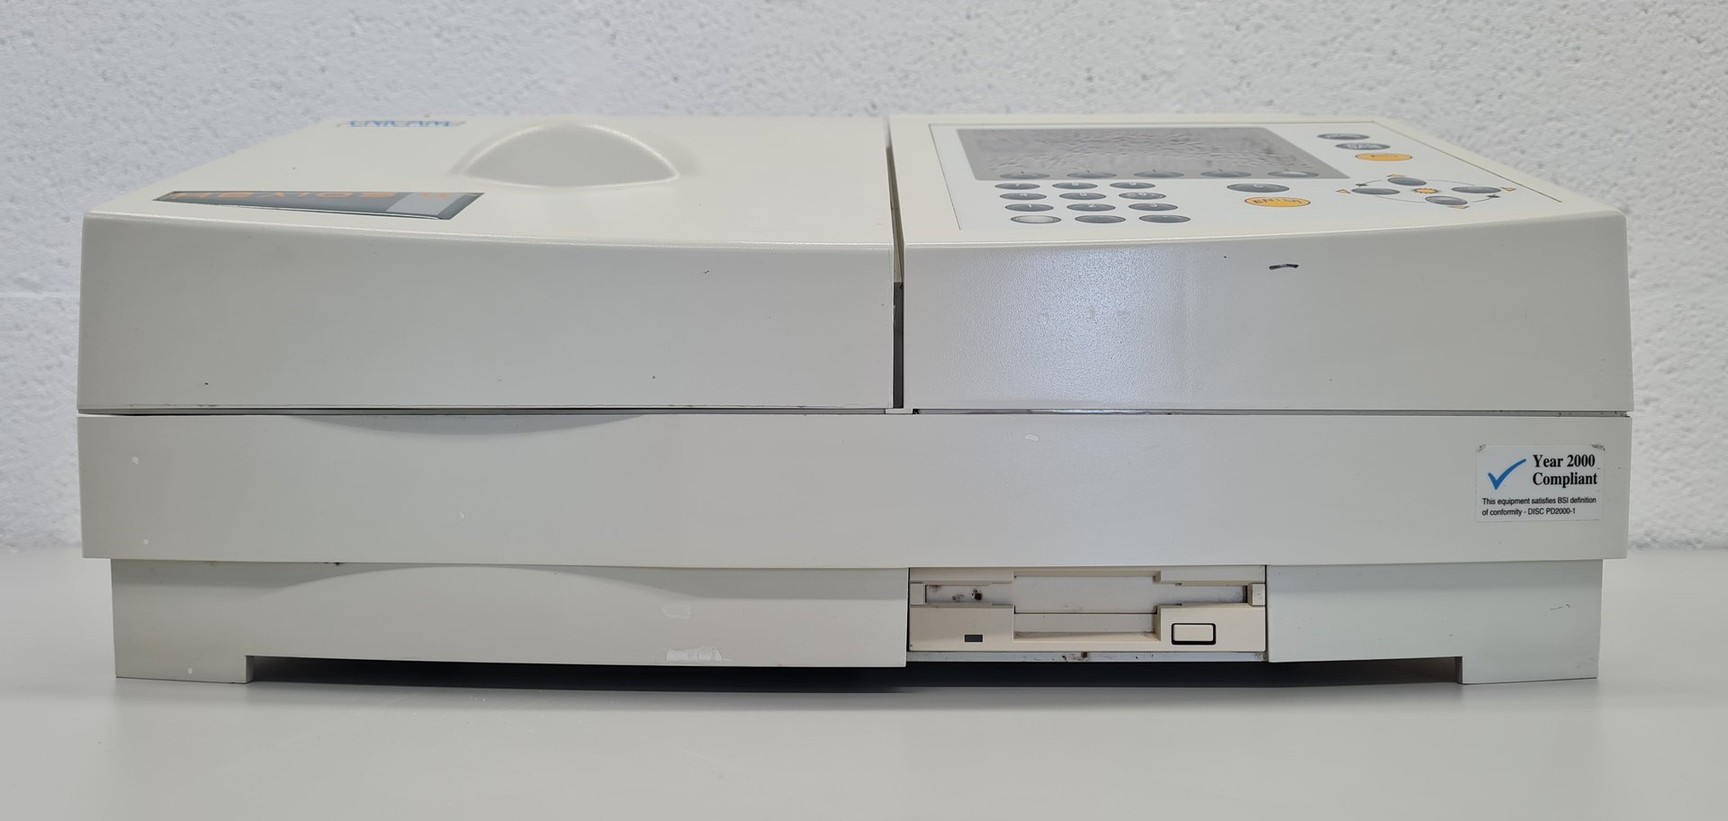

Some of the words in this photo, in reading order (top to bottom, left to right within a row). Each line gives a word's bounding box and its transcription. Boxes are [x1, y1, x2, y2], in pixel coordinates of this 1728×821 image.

[1532, 454, 1564, 468] Year
[1566, 454, 1596, 468] 2000
[1532, 472, 1598, 488] Compliant
[1497, 498, 1530, 506] equipment
[1570, 496, 1597, 504] definition
[1489, 508, 1522, 517] conformity
[1546, 507, 1576, 515] PD2000-1
